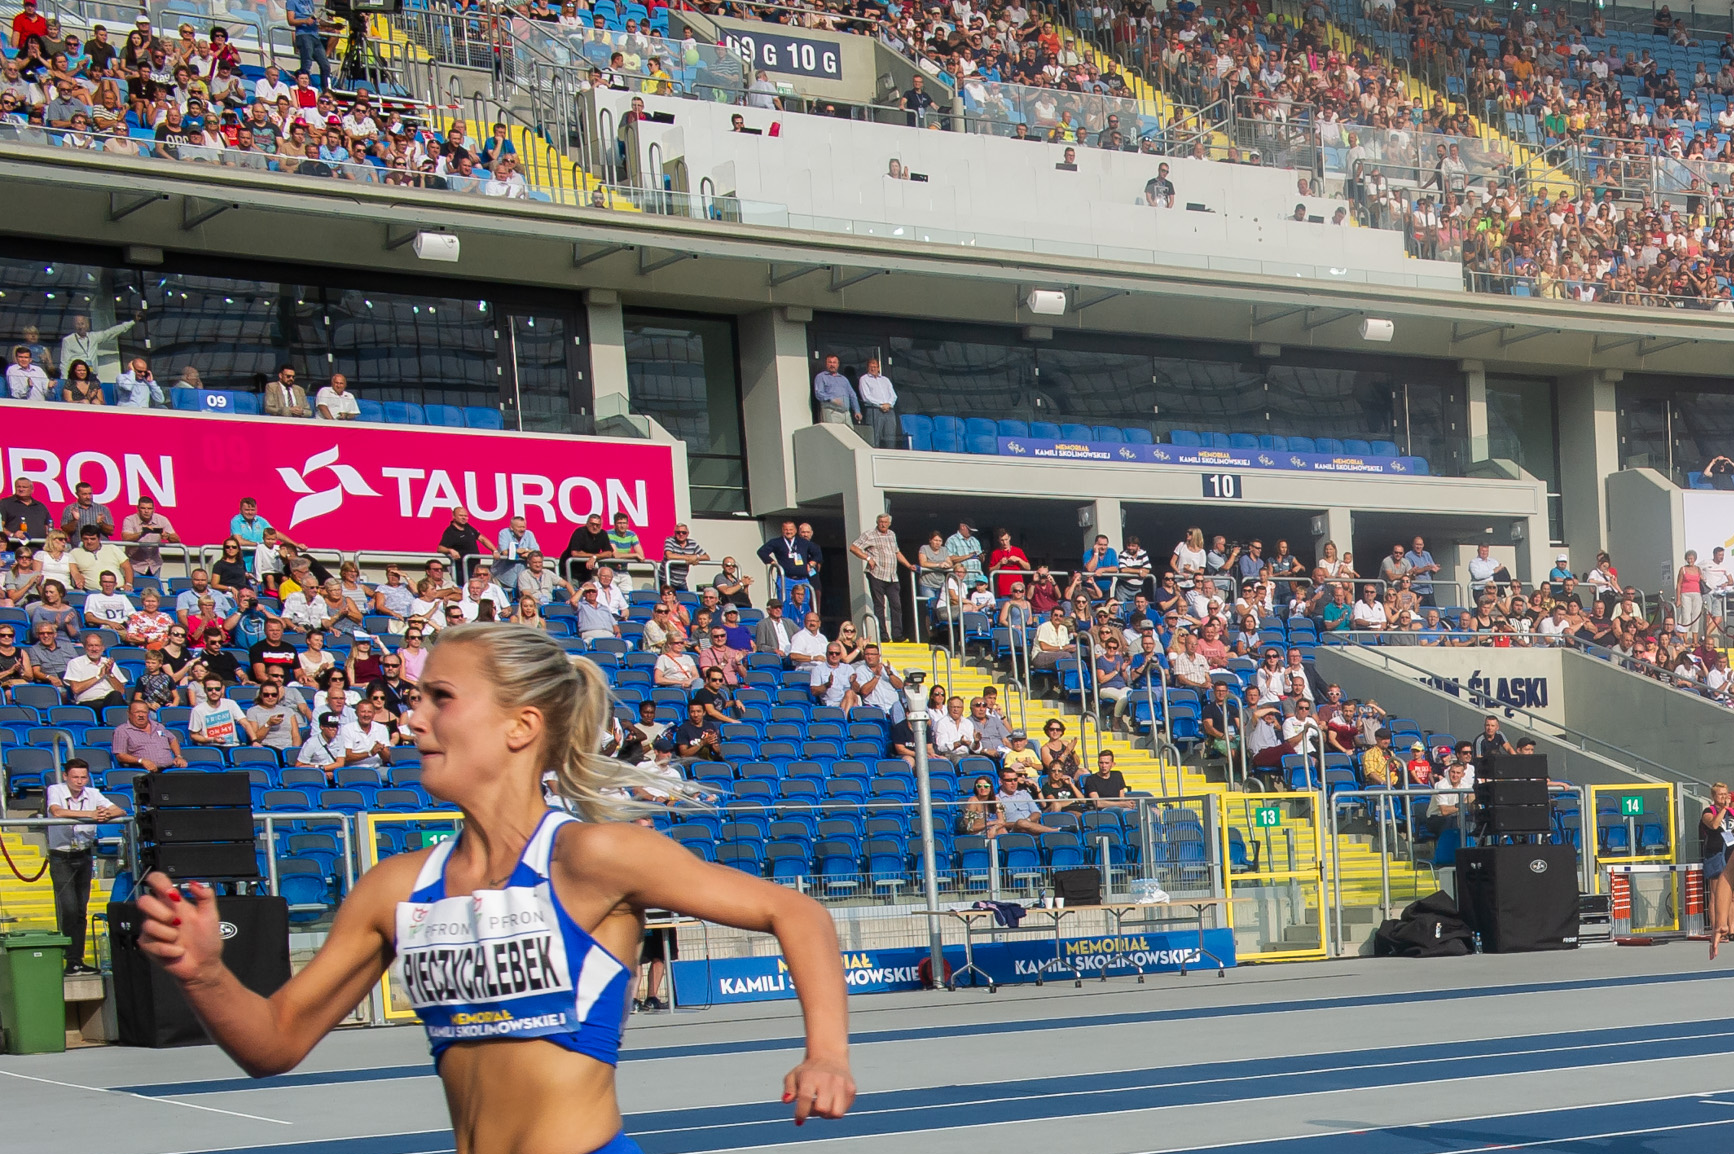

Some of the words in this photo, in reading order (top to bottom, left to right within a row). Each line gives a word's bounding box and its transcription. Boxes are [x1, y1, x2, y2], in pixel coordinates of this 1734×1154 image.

[763, 44, 777, 66] G
[787, 43, 816, 71] 10
[823, 52, 837, 73] G
[206, 394, 227, 408] 09
[1059, 450, 1111, 460] SKOLIMOWSKIEJ
[0, 447, 177, 508] RON
[1209, 475, 1235, 498] 10
[382, 466, 649, 528] TAURON
[1468, 670, 1549, 718] ŚLĄSKI
[206, 714, 230, 723] FRIDAY
[1626, 799, 1639, 812] 14
[1261, 809, 1276, 825] 13
[489, 910, 545, 929] PFRON
[1066, 936, 1149, 955] MEMORIAŁ
[404, 935, 562, 1003] PIECZYCHLEBEK
[778, 953, 872, 973] MIAŁ
[1015, 957, 1070, 975] KAMILI
[1074, 948, 1201, 971] SKOLIMOWSKIEJ
[720, 974, 786, 994] KAMILI
